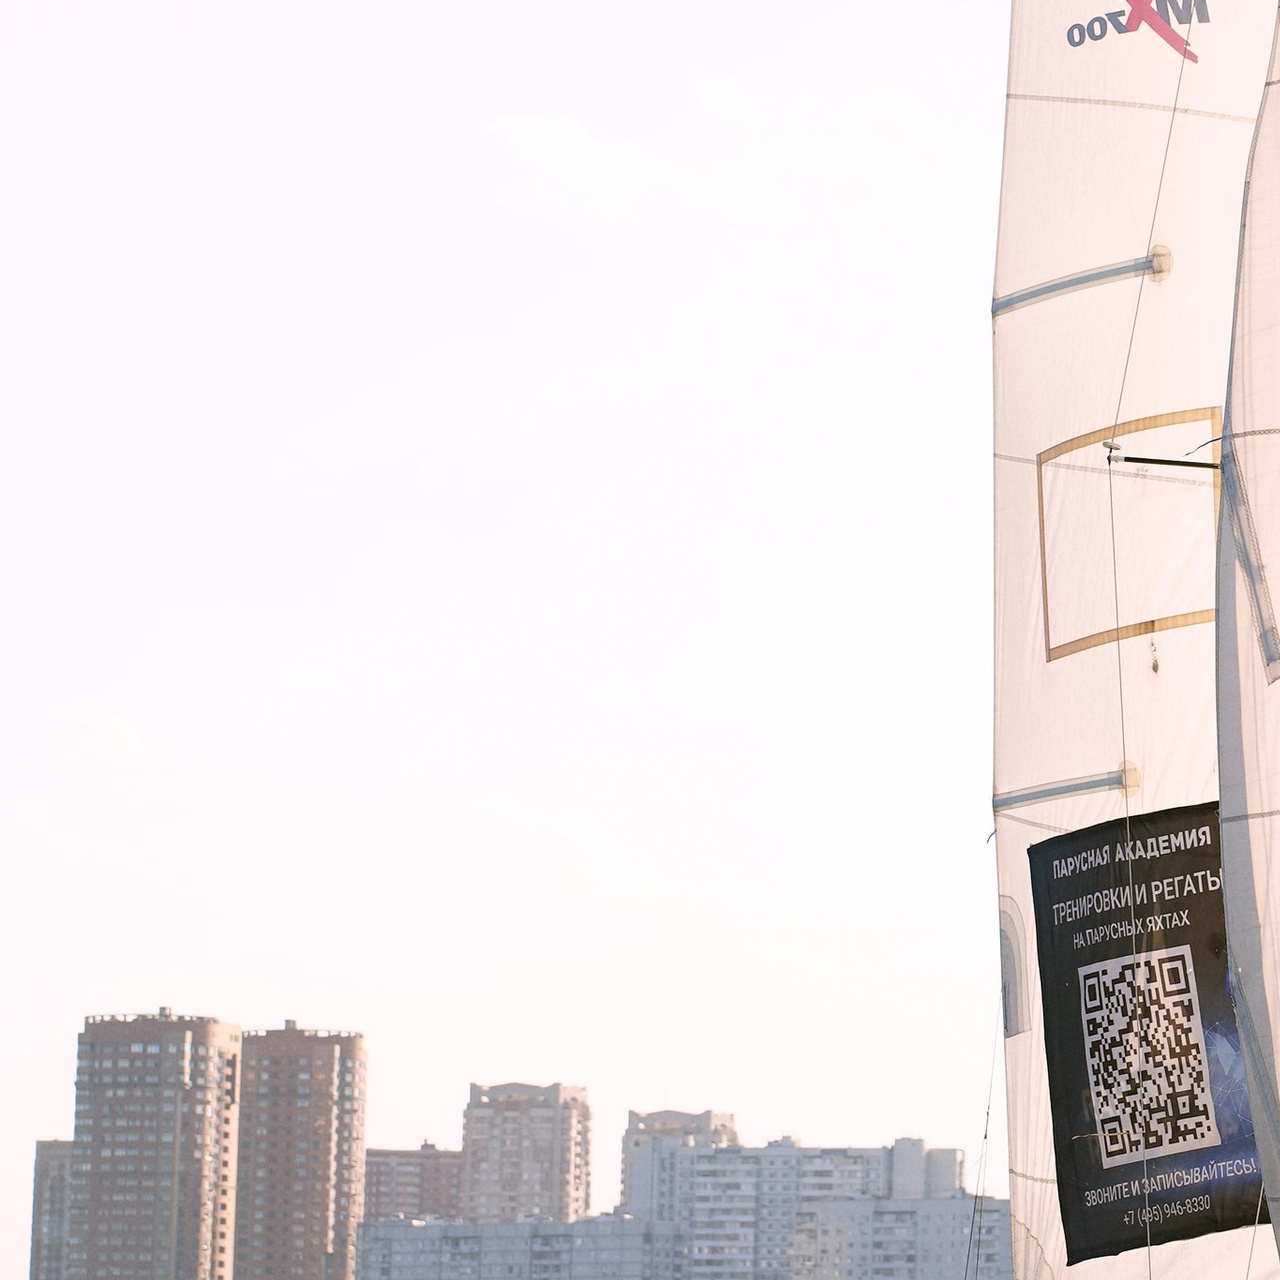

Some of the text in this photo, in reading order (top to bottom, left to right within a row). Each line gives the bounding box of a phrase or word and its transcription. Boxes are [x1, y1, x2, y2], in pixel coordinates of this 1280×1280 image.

[1053, 826, 1212, 880] ПАРУСНАЯ АКАДЕМИЯ
[1053, 868, 1223, 925] ТРЕНИРОВКИ И РЕГАТЫ
[1073, 909, 1190, 949] НА ПАРУСНЫХ ЯХТАХ
[1084, 1157, 1257, 1207] ЗВОНИТЕ И ЗАПИСЫВАЙТЕСЬ!
[1124, 1194, 1211, 1227] +7 (495) 946-8330
